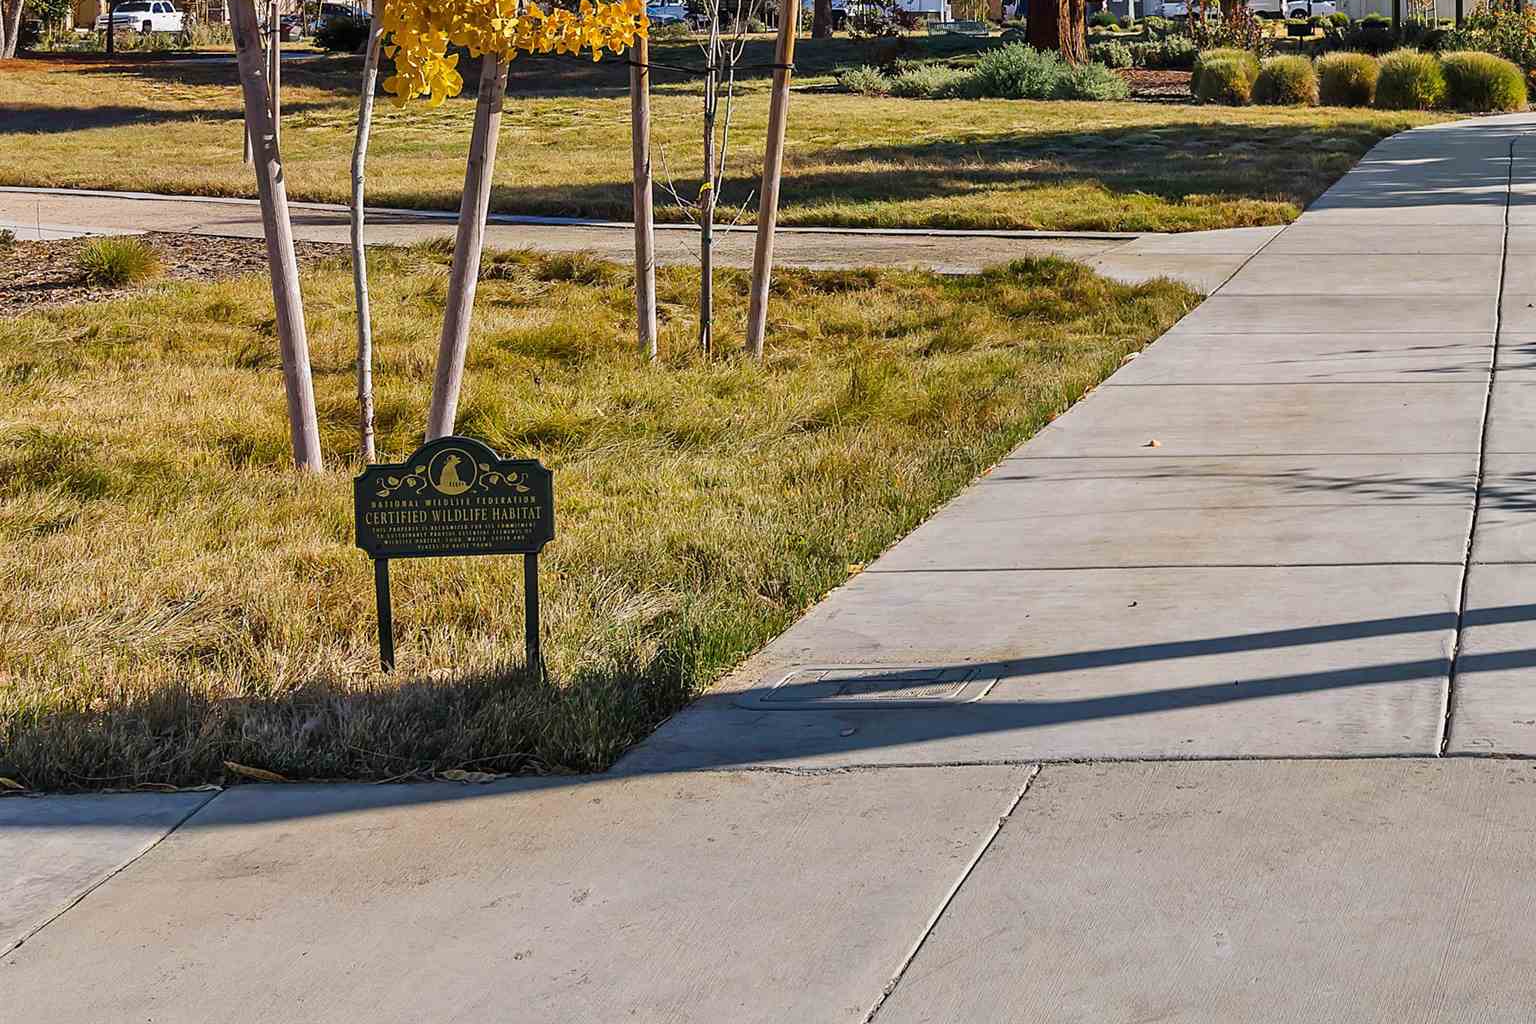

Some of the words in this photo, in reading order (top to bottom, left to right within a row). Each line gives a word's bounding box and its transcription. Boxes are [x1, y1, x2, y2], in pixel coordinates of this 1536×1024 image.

[366, 510, 427, 524] CERTIFIED
[432, 508, 488, 522] WILDLIFE
[492, 506, 542, 520] HABITAT
